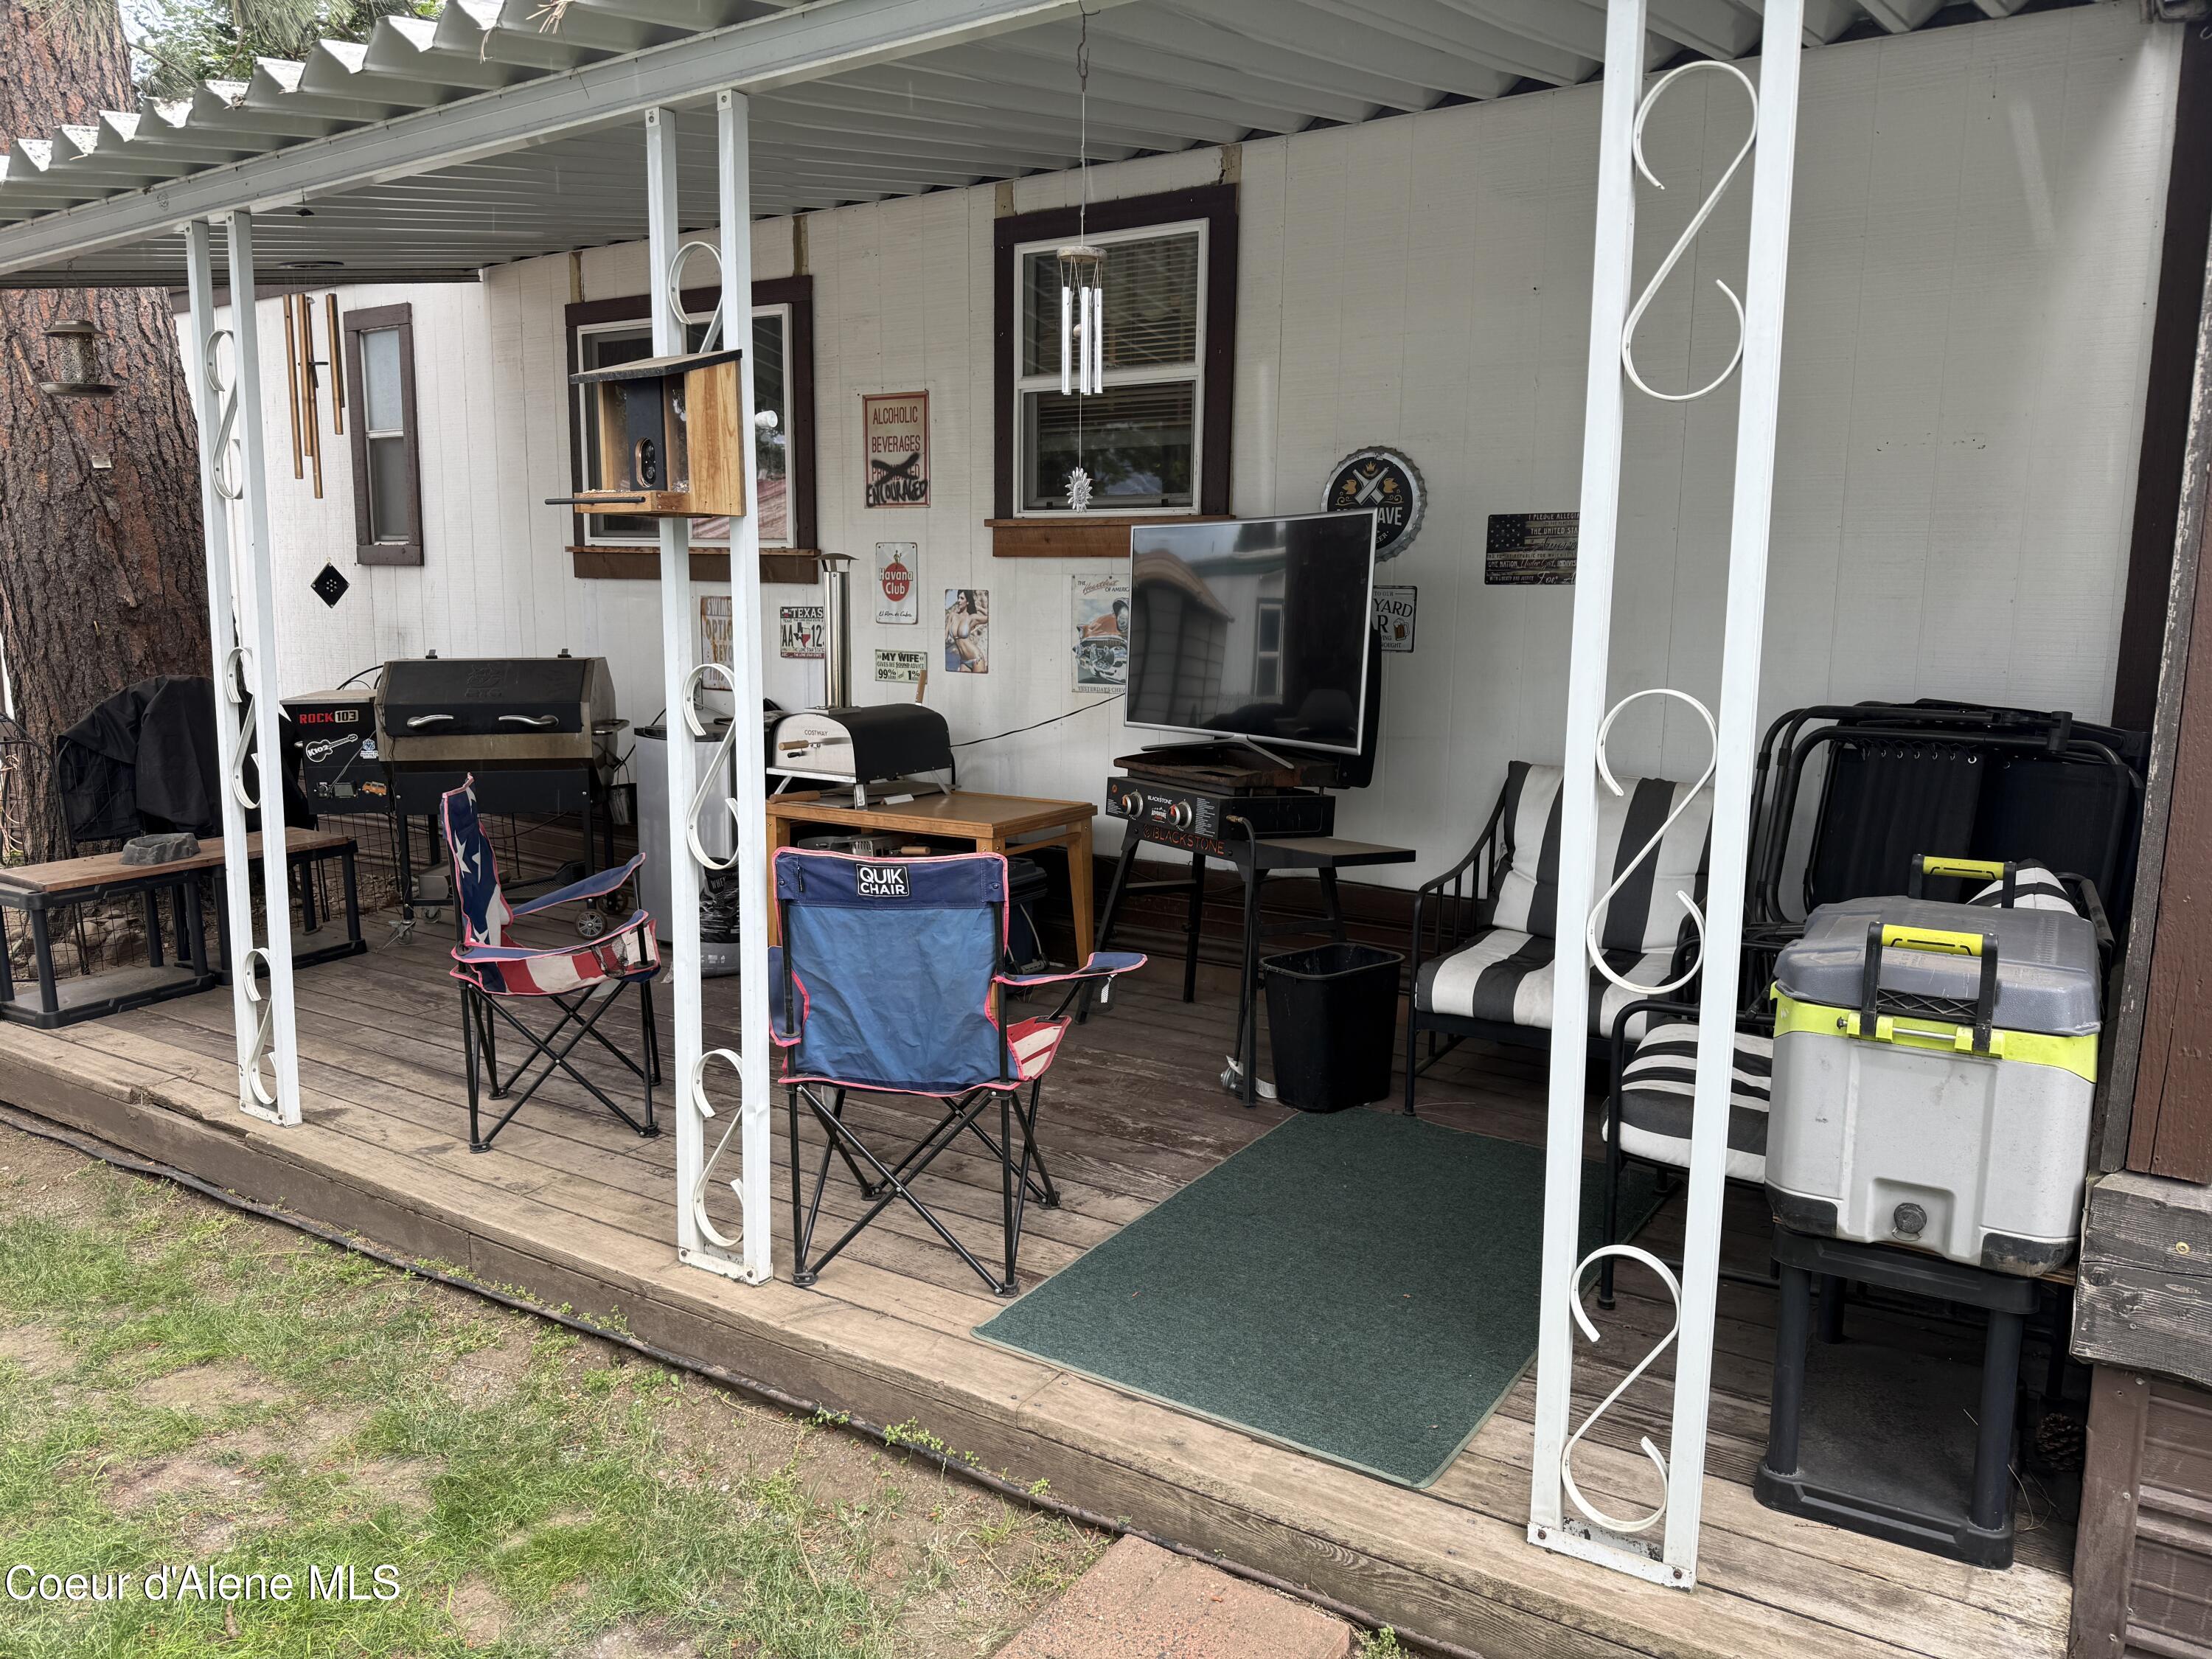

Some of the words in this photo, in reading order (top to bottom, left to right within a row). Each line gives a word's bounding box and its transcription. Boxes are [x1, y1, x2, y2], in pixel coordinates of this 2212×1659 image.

[872, 406, 918, 425] ALCOHOLIC
[872, 435, 920, 453] BEVERAGES
[866, 479, 928, 507] ENCOURAGED
[1376, 507, 1402, 526] AVE
[1543, 526, 1565, 535] UNITED
[878, 568, 913, 581] Havana
[886, 582, 905, 595] Club
[707, 597, 732, 616] SWIMS
[792, 608, 824, 618] TEXAS
[1373, 598, 1413, 617] YARD
[706, 619, 733, 641] OPTIO
[811, 624, 824, 647] 12
[713, 644, 733, 662] BEYO
[882, 653, 896, 661] MY
[897, 653, 919, 663] WIFE
[878, 668, 897, 679] 99%
[908, 670, 920, 681] 1%
[299, 712, 334, 724] ROCK
[1147, 795, 1173, 804] BLACKSTONE
[1152, 825, 1225, 855] BLACKSTONE
[860, 866, 904, 884] QUIK
